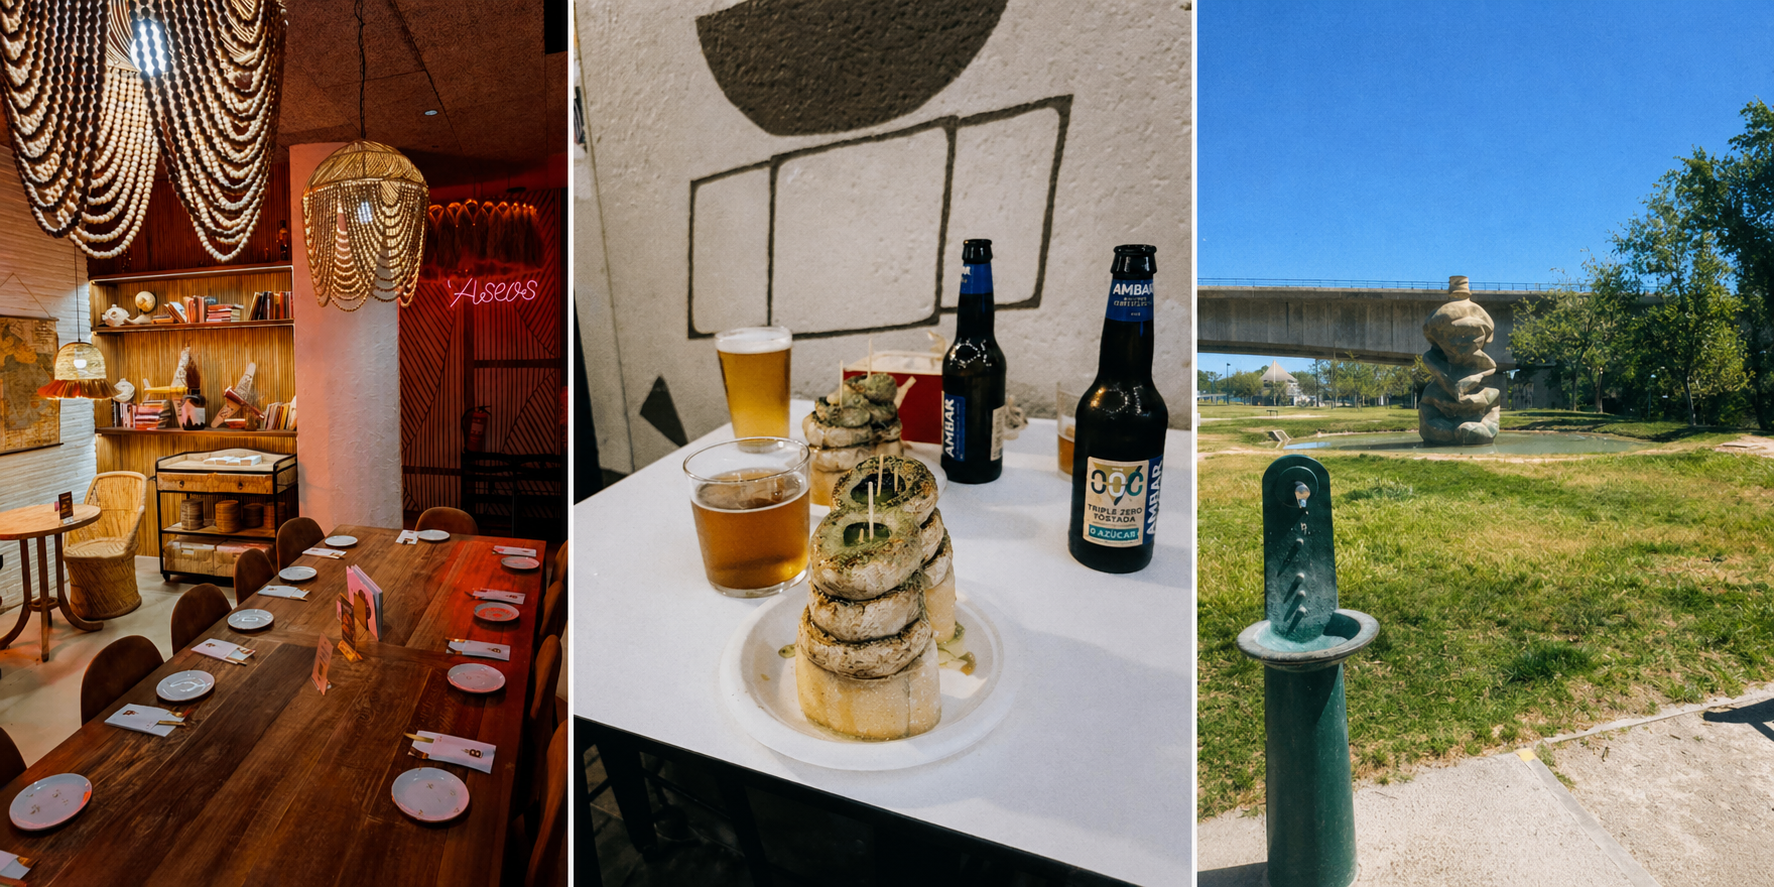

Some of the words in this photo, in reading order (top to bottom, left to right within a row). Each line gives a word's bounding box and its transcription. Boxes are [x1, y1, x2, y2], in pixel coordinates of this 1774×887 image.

[449, 277, 538, 308] Aseos
[944, 398, 955, 459] AMBAR
[1087, 503, 1118, 516] TRIPLE
[1120, 507, 1143, 516] ZERO
[1093, 513, 1136, 523] TOSTADA
